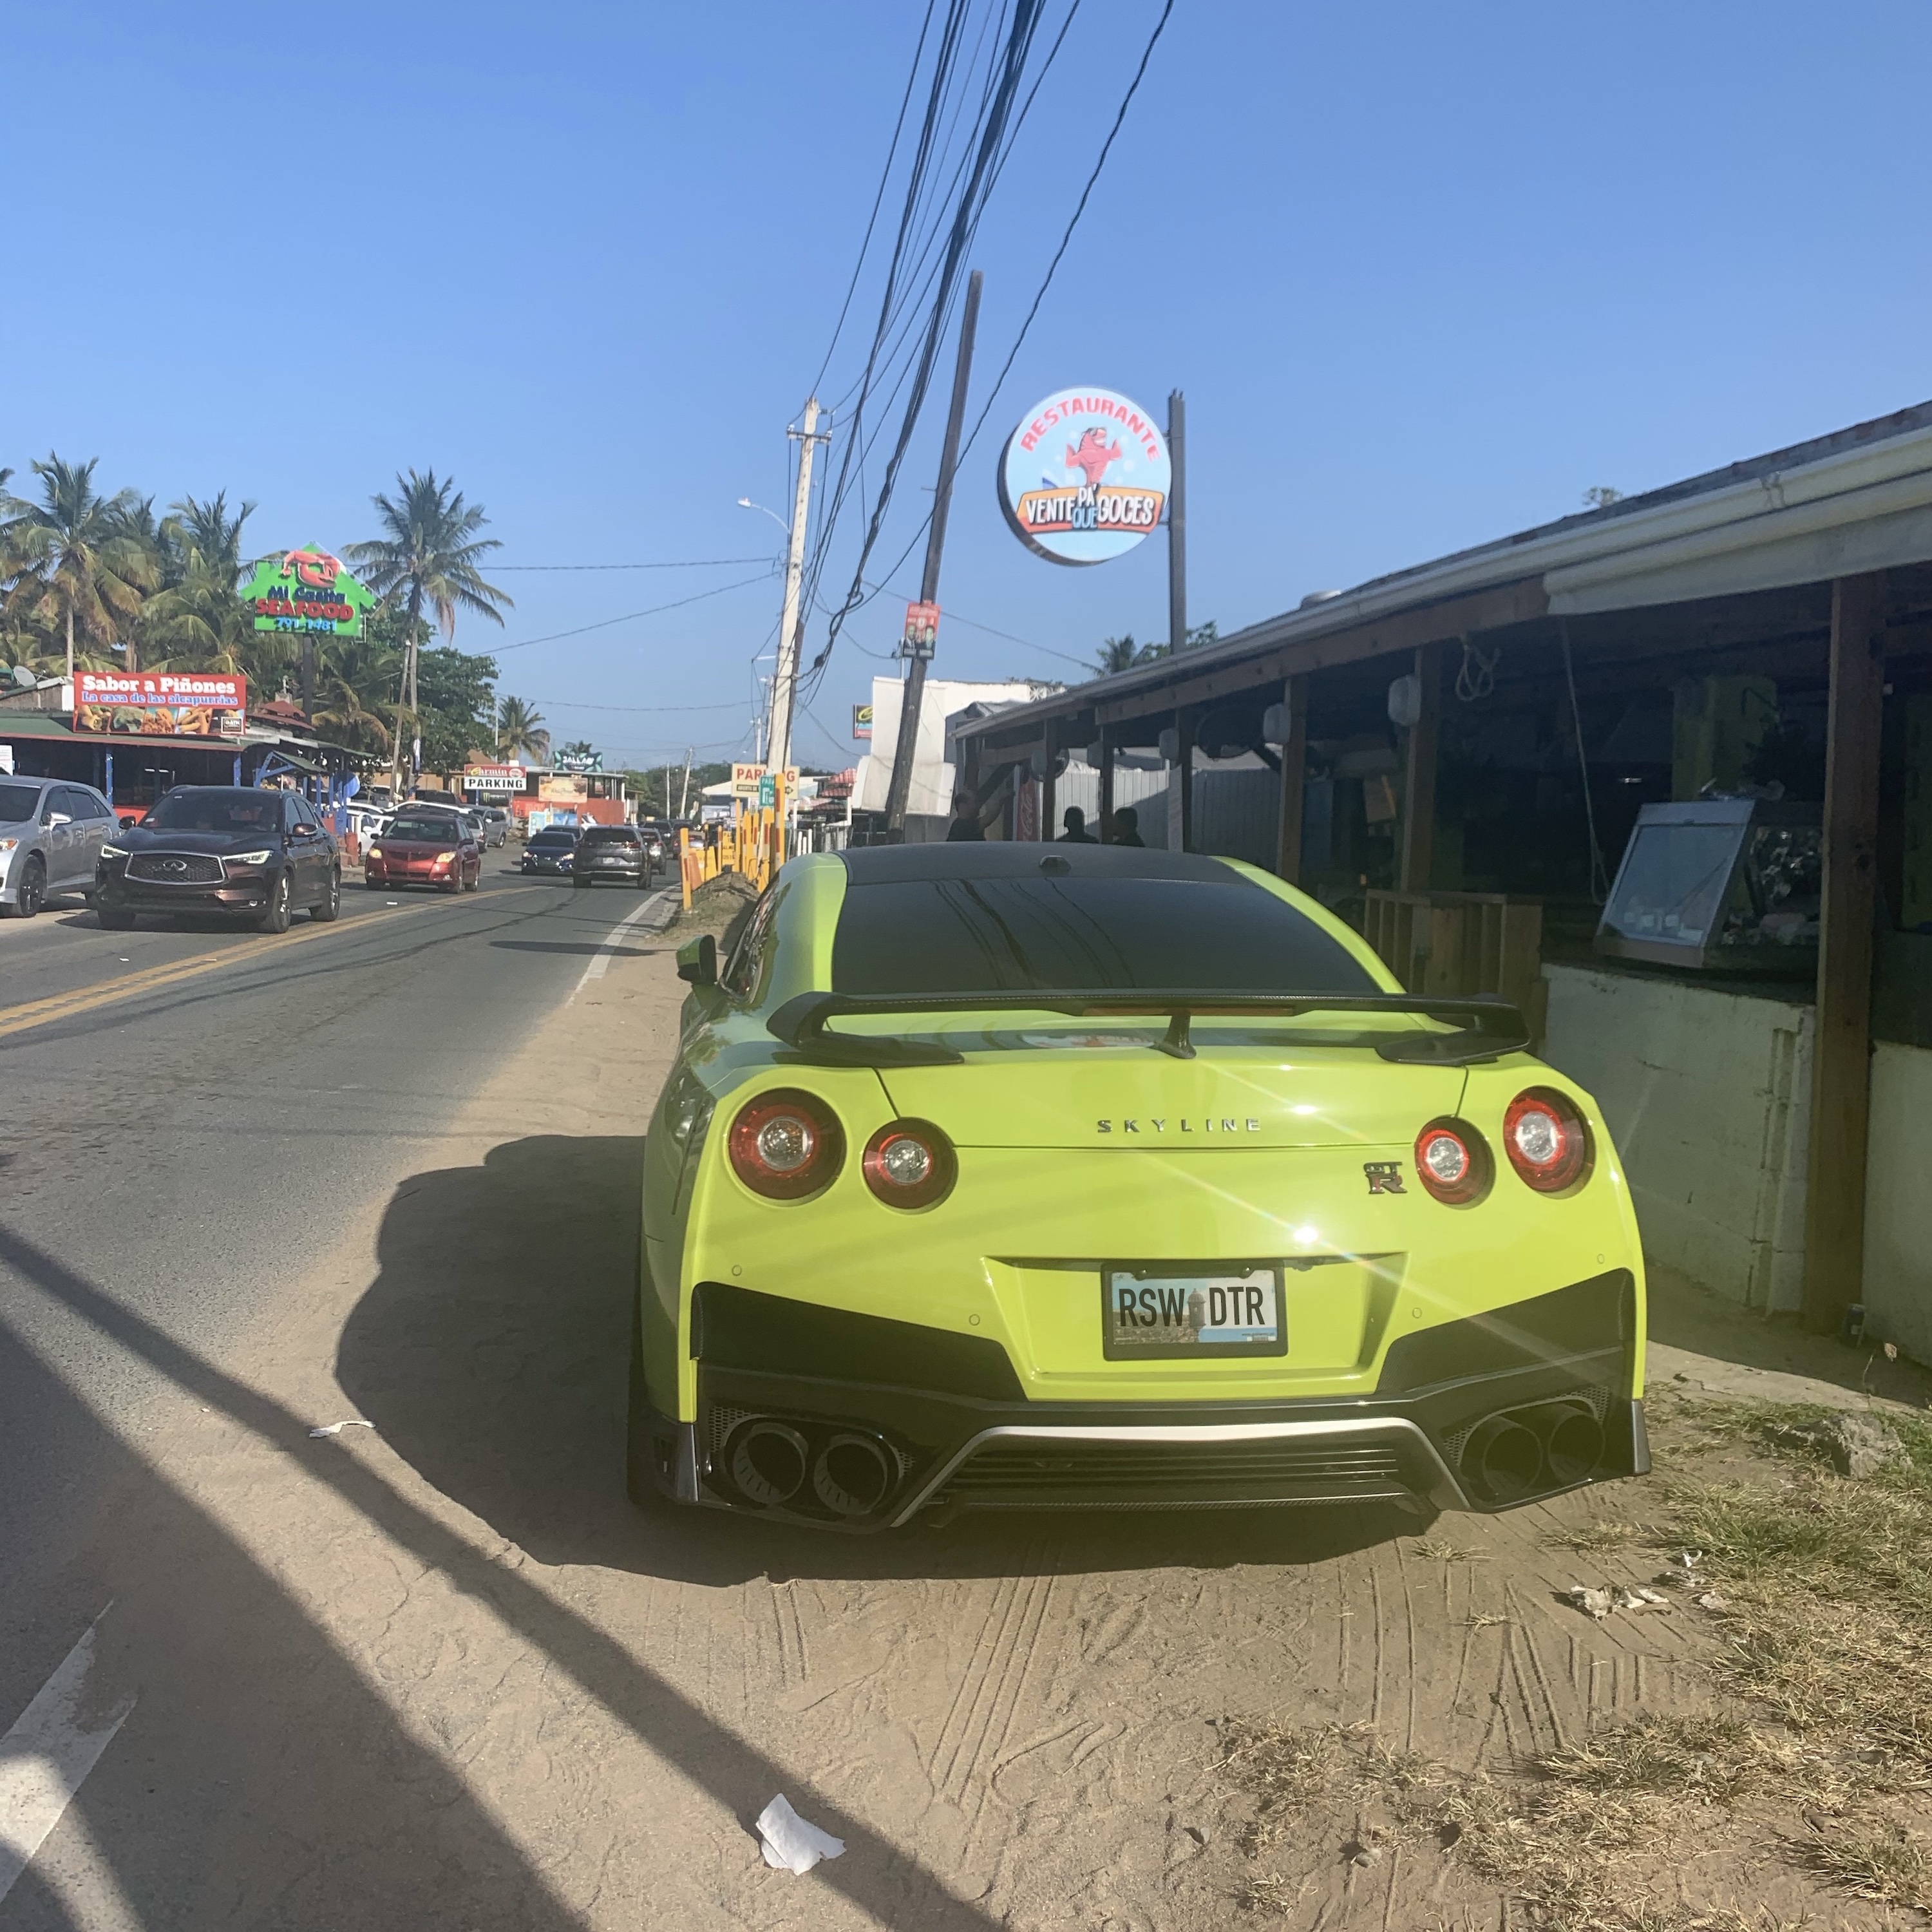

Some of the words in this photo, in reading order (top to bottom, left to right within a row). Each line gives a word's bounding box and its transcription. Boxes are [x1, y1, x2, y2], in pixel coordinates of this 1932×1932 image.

[1021, 396, 1160, 462] RESTAURANTE
[1025, 497, 1076, 525] VENTE
[1072, 507, 1099, 529] QUE
[1097, 495, 1155, 526] GOCES
[256, 598, 355, 620] SEAFOOD
[82, 675, 140, 692] Sabor
[144, 679, 156, 692] a
[160, 677, 236, 694] Piñones
[82, 691, 98, 702] La
[100, 693, 128, 703] casa
[130, 692, 146, 703] de
[147, 693, 166, 703] las
[169, 693, 238, 706] alcapurrias
[469, 779, 523, 788] PARKING
[737, 768, 795, 782] PARG
[1097, 1119, 1260, 1133] SKYLINE
[1119, 1288, 1185, 1327] RSW
[1209, 1286, 1265, 1326] DTR
